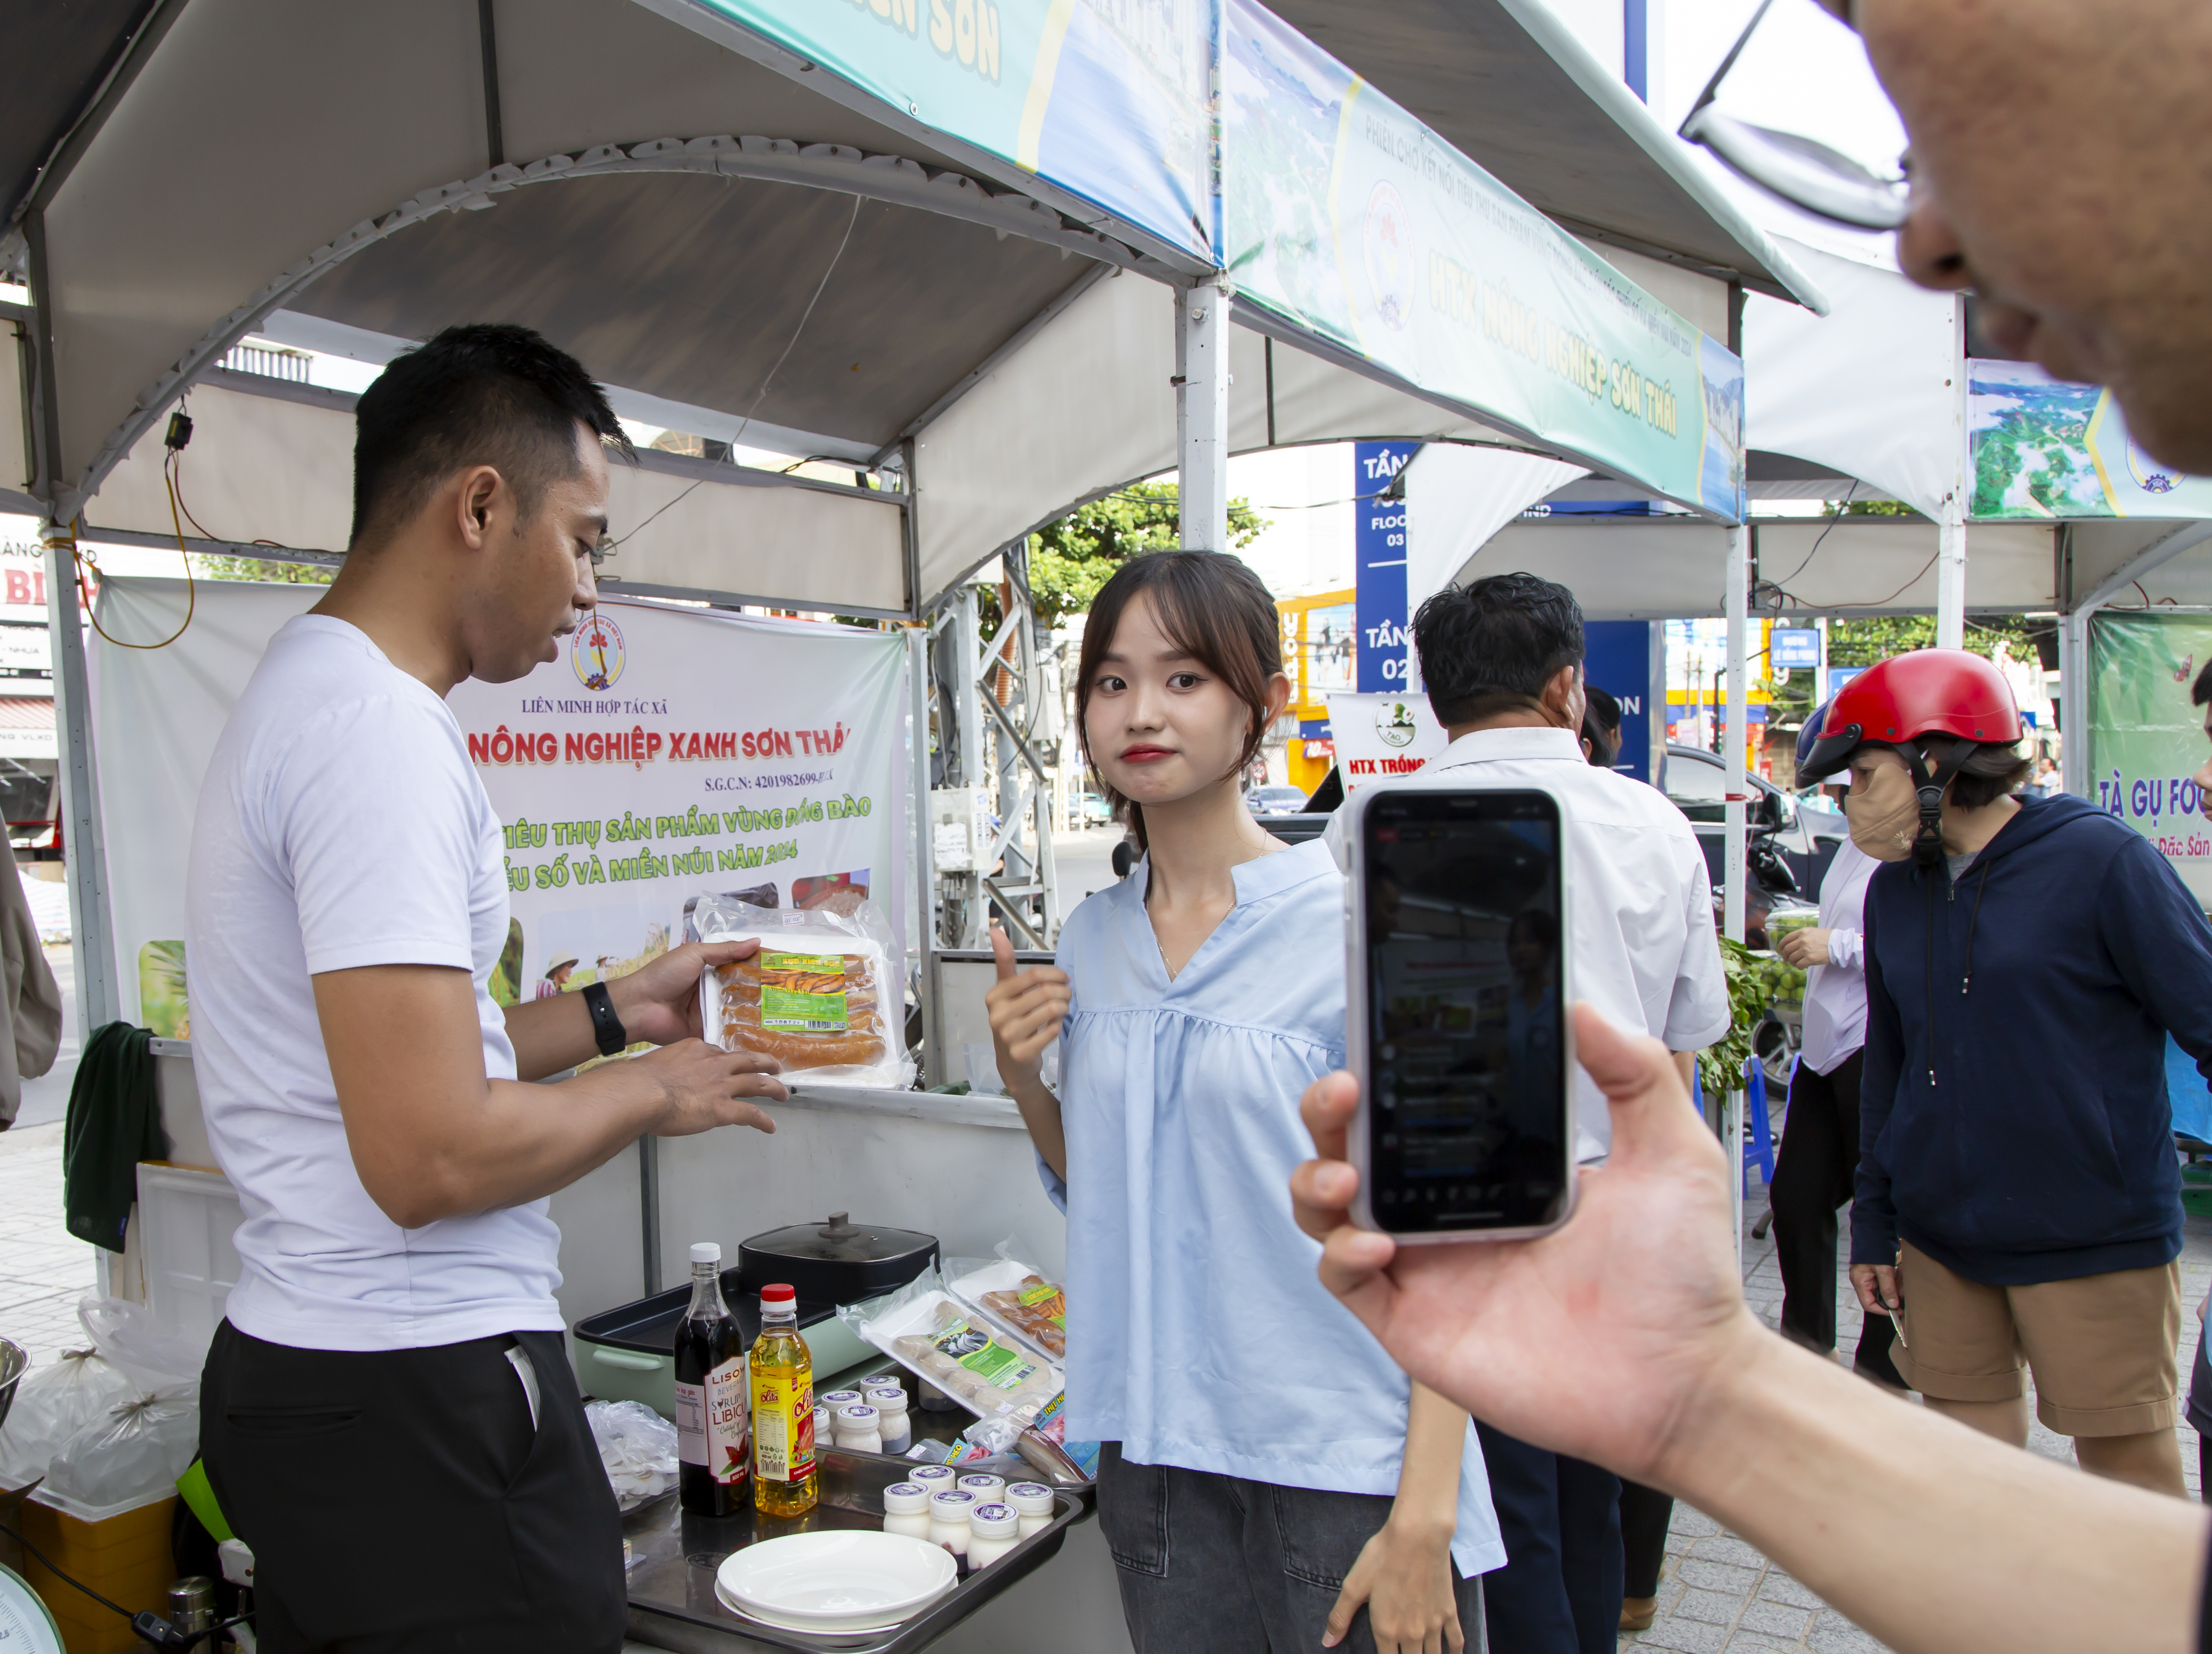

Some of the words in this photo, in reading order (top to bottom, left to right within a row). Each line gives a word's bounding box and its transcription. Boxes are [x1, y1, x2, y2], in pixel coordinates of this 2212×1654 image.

[1366, 113, 1394, 157] PHIÊN
[1397, 136, 1419, 179] CHỢ
[1421, 148, 1436, 184] KẾT
[1439, 161, 1455, 197] NỐI
[1429, 248, 1477, 331] HTX
[1483, 275, 1540, 365] NÔNG
[1543, 316, 1607, 406] NGHIỆP
[1611, 358, 1641, 419] SƠN
[1644, 379, 1677, 440] THÁI
[1387, 533, 1404, 547] 03
[1382, 658, 1407, 680] 02
[522, 695, 554, 714] LIÊN
[557, 700, 592, 714] MINH
[595, 699, 621, 717] HỢP
[624, 698, 649, 714] TÁC
[651, 699, 668, 715] XÃ
[468, 724, 558, 764] NÔNG
[565, 724, 663, 771] NGHIỆP
[668, 732, 738, 760] XANH
[741, 727, 794, 758] SƠN
[1349, 759, 1377, 774] HTX
[705, 776, 752, 792] S.G.C.N:
[2099, 769, 2124, 818] TÀ
[2131, 779, 2162, 827] GỤ
[501, 818, 547, 849] IÊU
[551, 821, 601, 850] THỤ
[606, 811, 652, 842] SẢN
[656, 805, 720, 839] PHẨM
[722, 805, 783, 833] VÙNG
[826, 793, 871, 820] BÀO
[535, 853, 570, 889] SỐ
[572, 854, 607, 885] VÀ
[609, 846, 669, 882] MIỀN
[672, 846, 714, 876] NÚI
[717, 843, 763, 872] NĂM
[764, 838, 799, 865] 2024
[711, 1393, 741, 1411] SYRUP
[761, 1389, 779, 1403] olita
[950, 1443, 963, 1459] HEO
